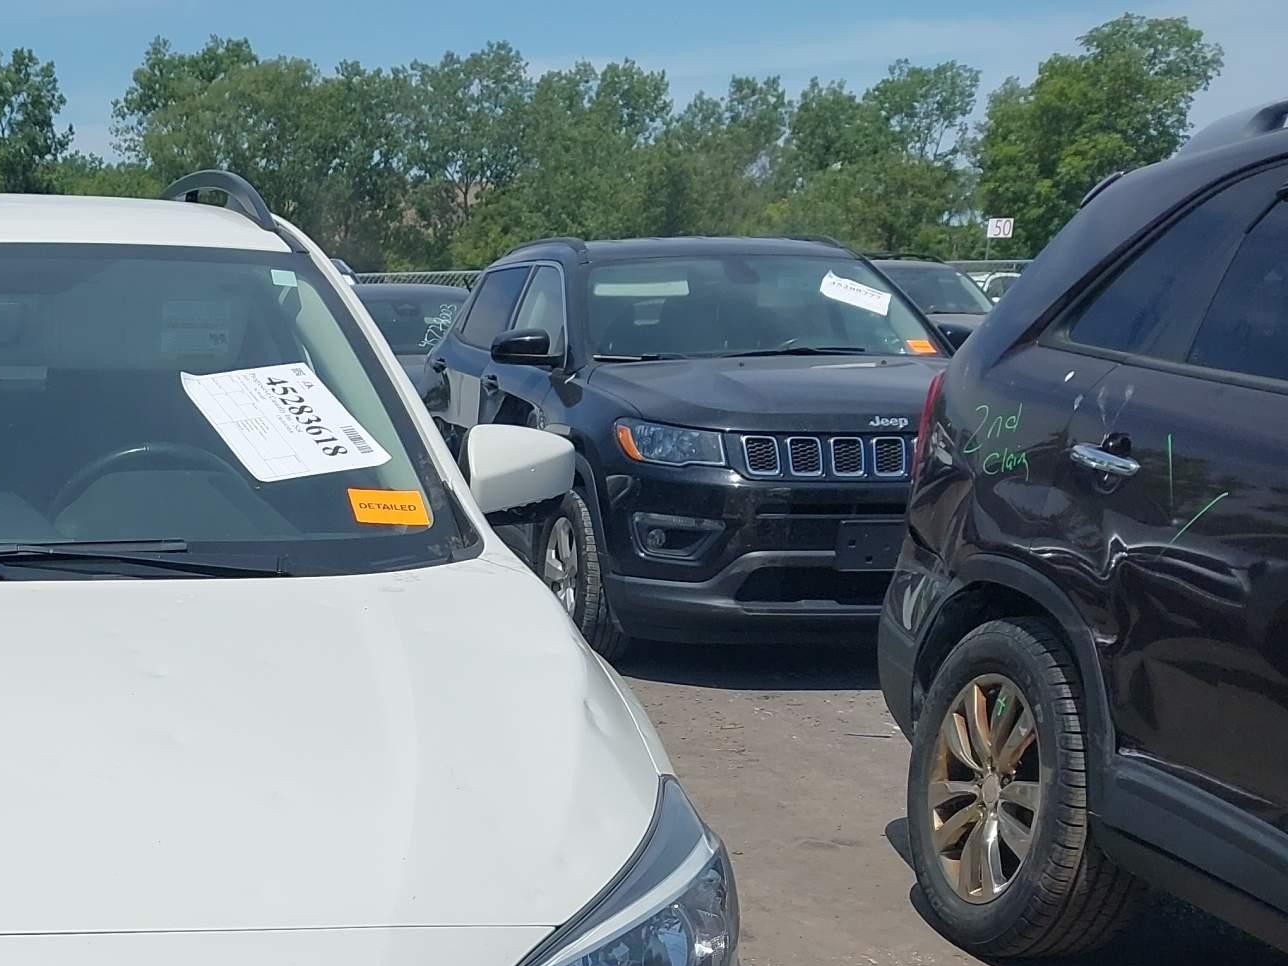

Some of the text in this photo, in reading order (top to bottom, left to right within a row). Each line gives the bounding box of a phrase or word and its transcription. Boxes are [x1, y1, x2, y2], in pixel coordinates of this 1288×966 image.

[993, 219, 1012, 237] 50
[265, 376, 349, 457] 45283618
[868, 415, 909, 428] Jeep
[963, 402, 1023, 454] 2nd
[359, 502, 417, 512] DETAILED
